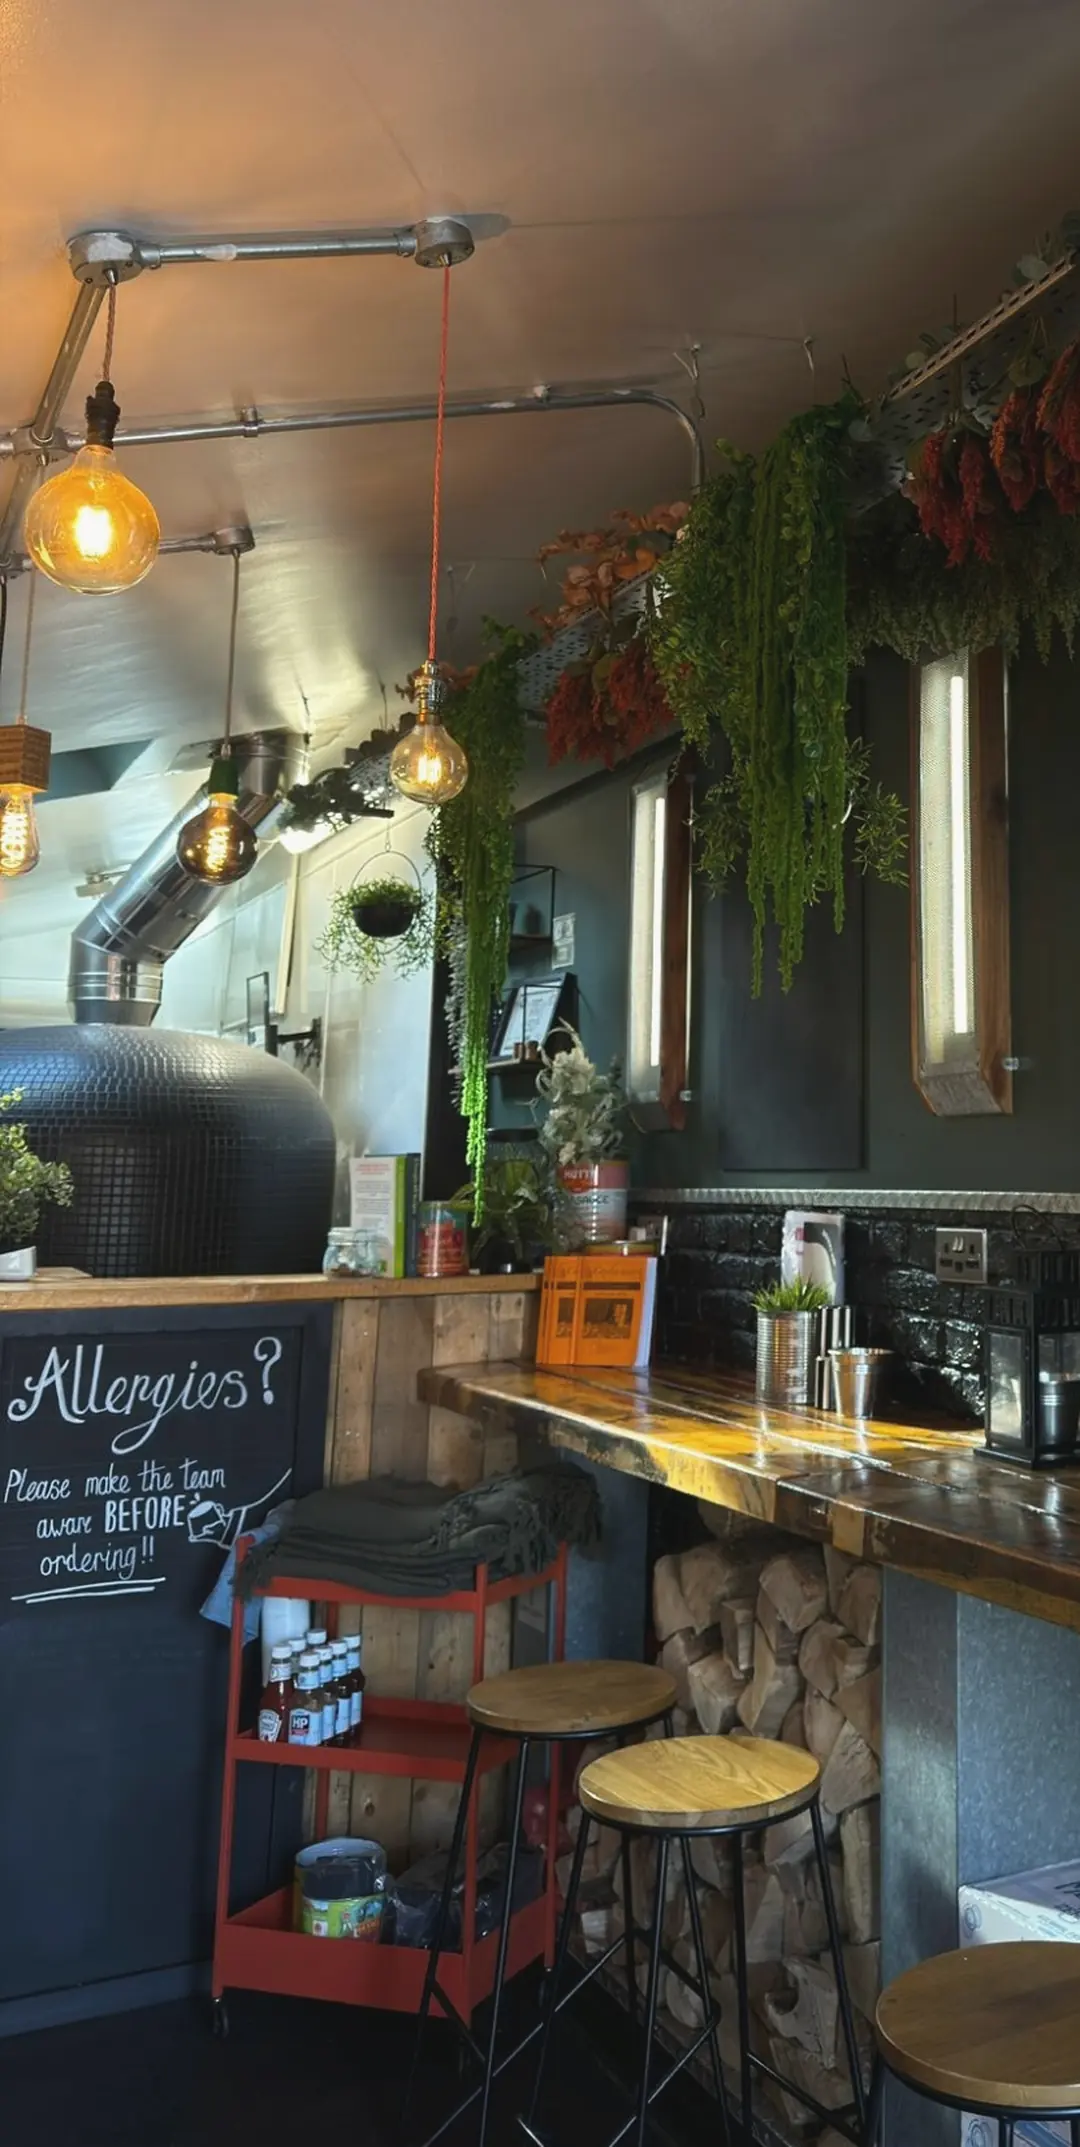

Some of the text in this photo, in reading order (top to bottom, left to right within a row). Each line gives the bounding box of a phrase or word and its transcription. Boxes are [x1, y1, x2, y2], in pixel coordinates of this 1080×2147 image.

[7, 1336, 282, 1455] Allergies?
[4, 1457, 226, 1503] Please make the team
[36, 1494, 186, 1539] aware BEFORE
[40, 1535, 154, 1580] ordering!!
[292, 1717, 308, 1728] HP
